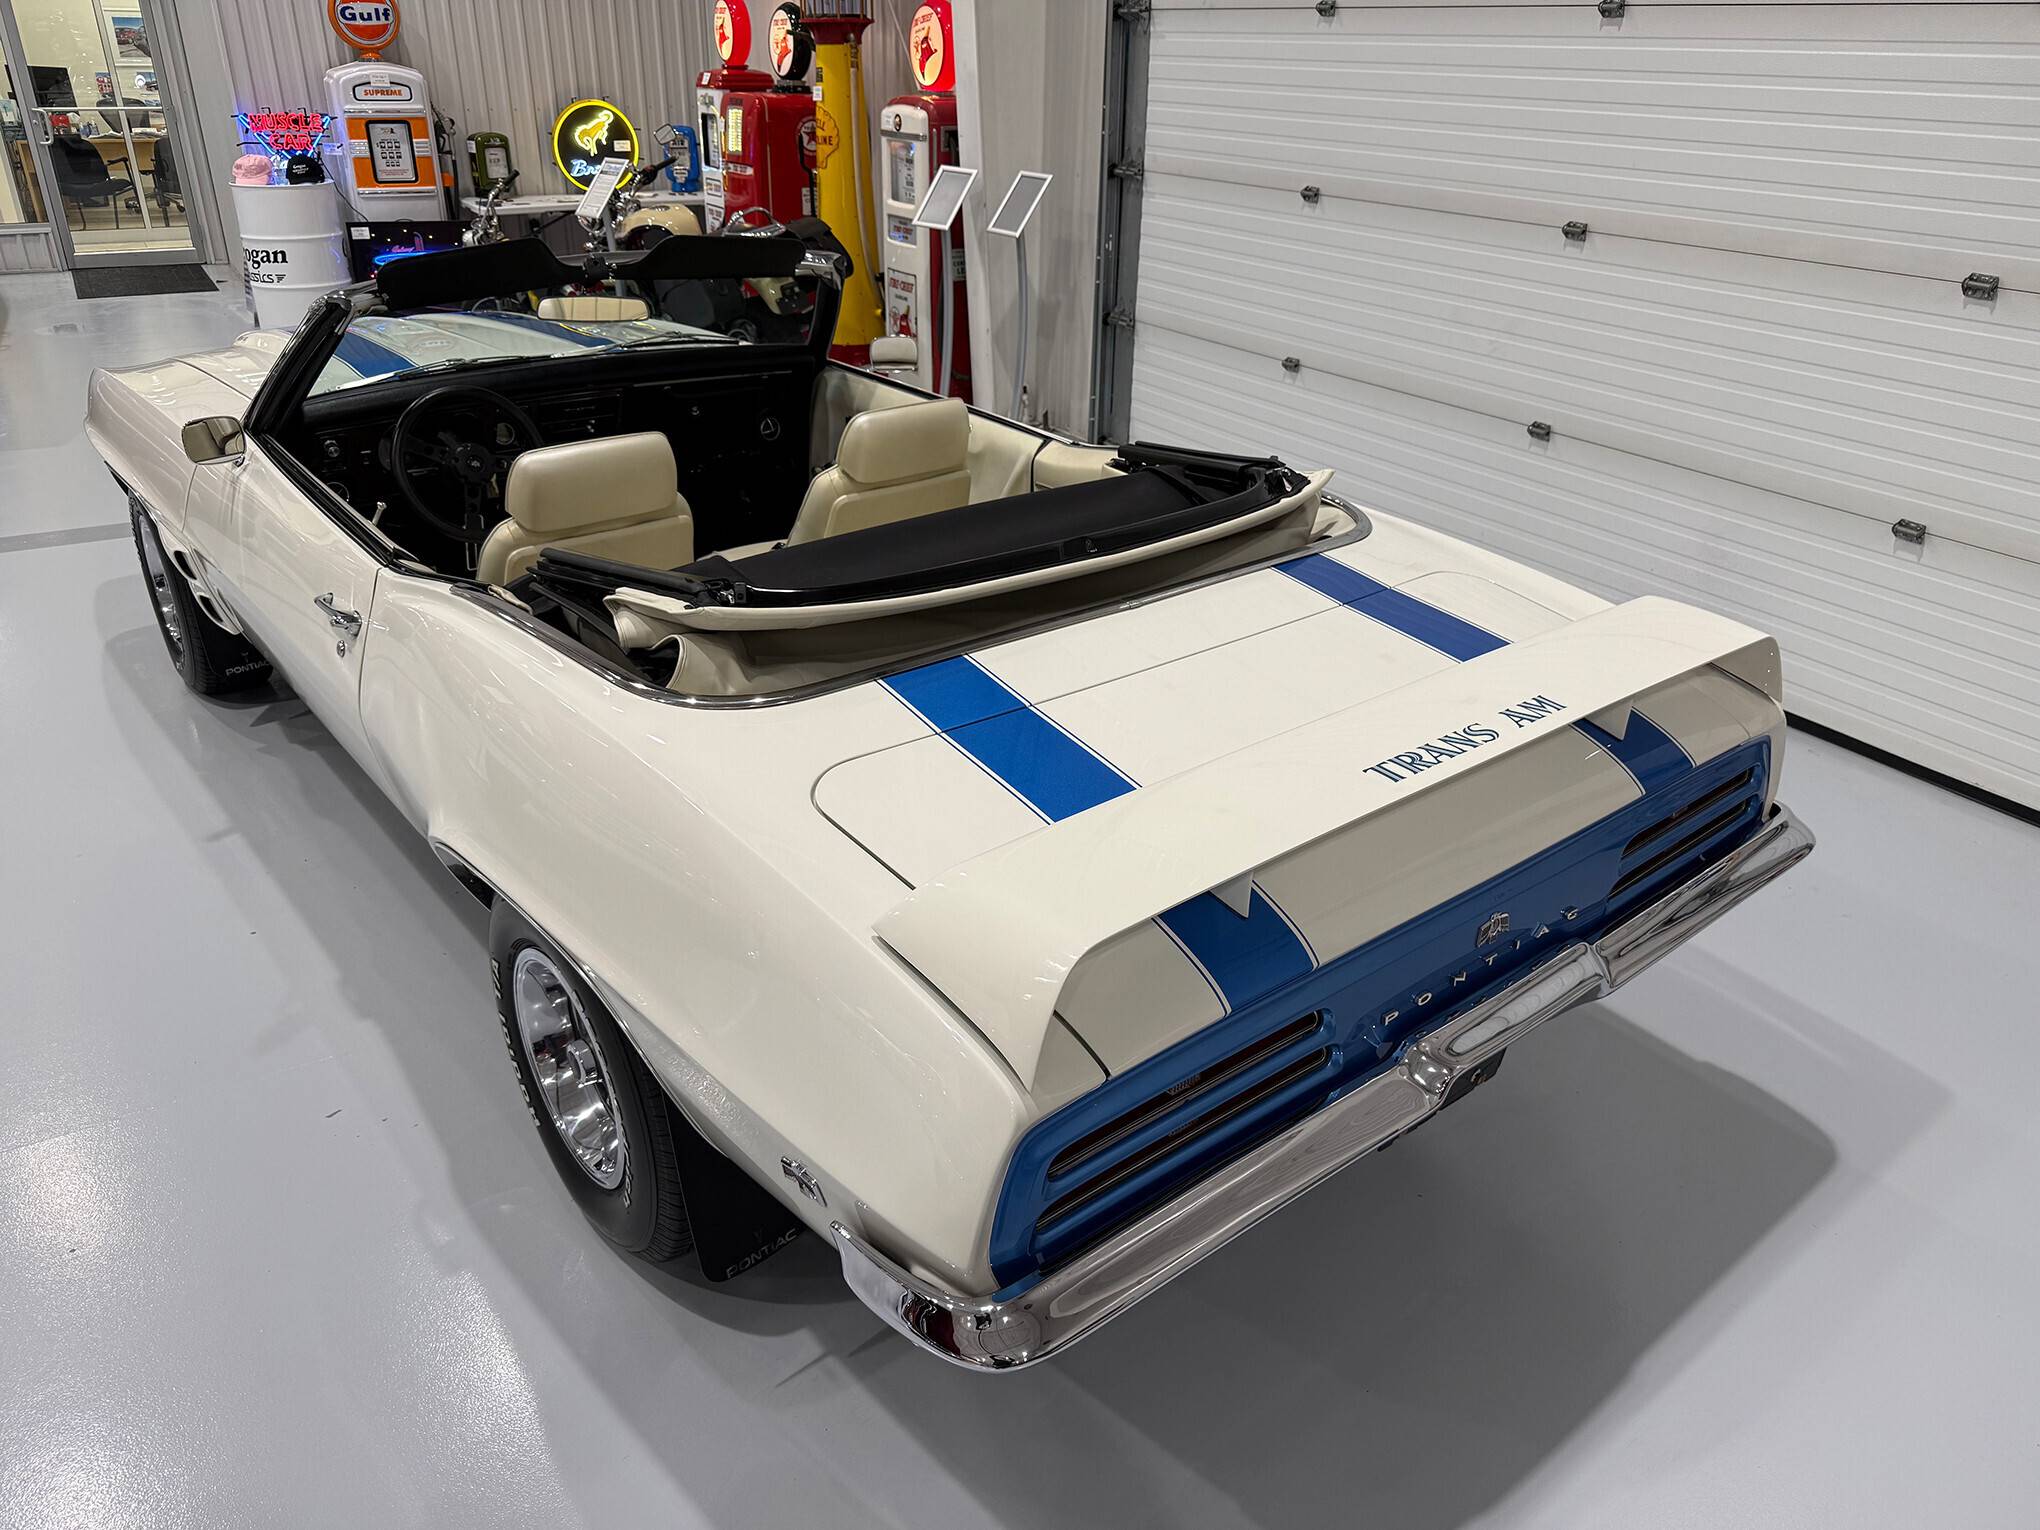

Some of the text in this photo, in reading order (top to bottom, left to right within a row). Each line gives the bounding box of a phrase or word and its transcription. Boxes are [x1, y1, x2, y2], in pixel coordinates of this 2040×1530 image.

[340, 5, 391, 22] Gulf
[363, 89, 402, 97] SUPREME
[248, 111, 323, 132] MUSCLE
[268, 132, 313, 150] CAR
[570, 158, 601, 177] Bro
[245, 248, 288, 269] ogan
[1362, 694, 1568, 783] TRANS AM
[1381, 905, 1580, 1026] PONTIAC
[726, 1227, 798, 1279] PONTIAC
